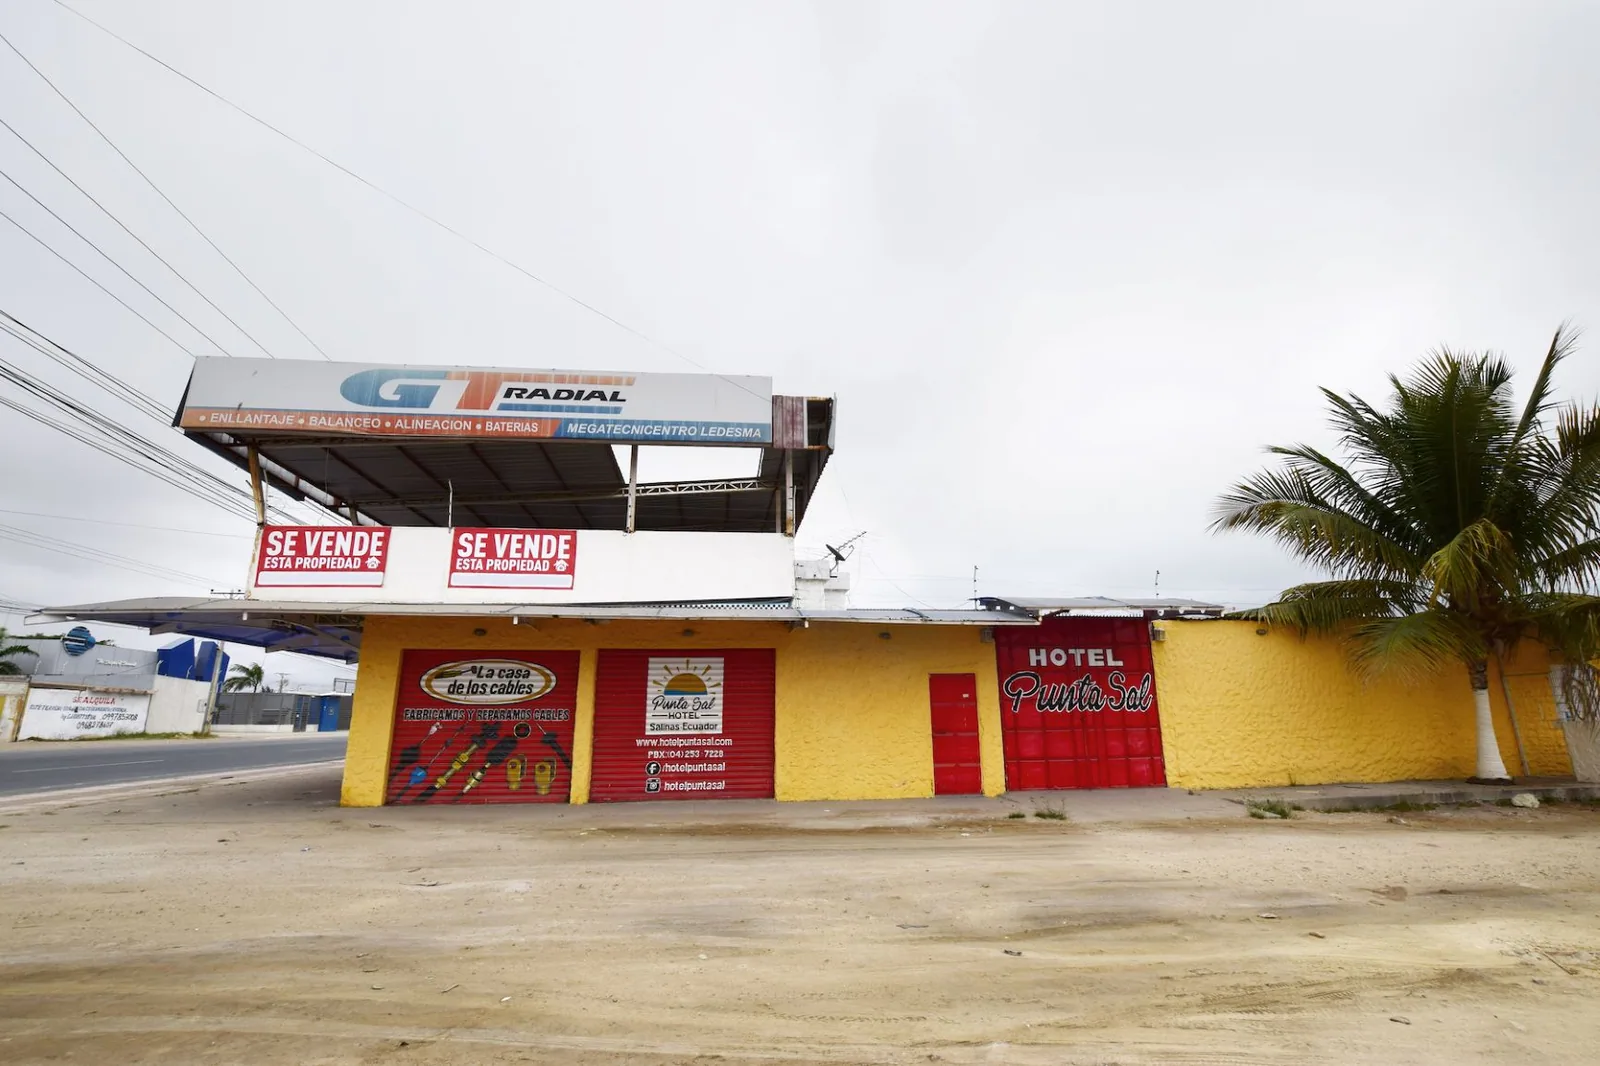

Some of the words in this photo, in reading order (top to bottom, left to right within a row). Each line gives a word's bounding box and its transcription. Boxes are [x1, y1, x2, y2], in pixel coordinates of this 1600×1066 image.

[503, 387, 627, 402] RADIAL
[210, 412, 295, 425] ENLLANTAJE
[309, 415, 381, 429] BALANCEO
[394, 418, 473, 431] ALINEACION
[485, 421, 538, 433] BATERIAS
[567, 423, 697, 437] MEGATECNICENTRO
[700, 427, 762, 439] LEDESMA
[266, 531, 299, 556] SE
[304, 531, 385, 557] VENDE
[457, 533, 489, 558] SE
[494, 534, 571, 560] VENDE
[264, 556, 293, 569] ESTA
[294, 556, 361, 569] PROPIEDAD
[456, 558, 484, 570] ESTA
[486, 559, 550, 572] PROPIEDAD
[1029, 648, 1124, 667] HOTEL
[476, 666, 495, 679] La
[497, 669, 531, 679] casa
[447, 681, 466, 695] de
[466, 681, 488, 695] los
[489, 681, 534, 695] cables
[1003, 671, 1107, 713] Punta
[1104, 671, 1152, 713] Sal
[652, 695, 690, 710] Punta
[692, 696, 716, 711] Sal
[404, 709, 465, 721] FABRICAMOS
[467, 709, 475, 721] Y
[476, 709, 531, 721] REPARAMOS
[533, 709, 570, 721] CABLES
[650, 723, 680, 731] Salinas
[682, 722, 718, 731] Ecuador
[635, 737, 733, 747] www.hotelpuntasal.com
[684, 750, 700, 758] 253
[704, 750, 724, 758] 7228
[664, 781, 725, 791] hotelpuntasal
